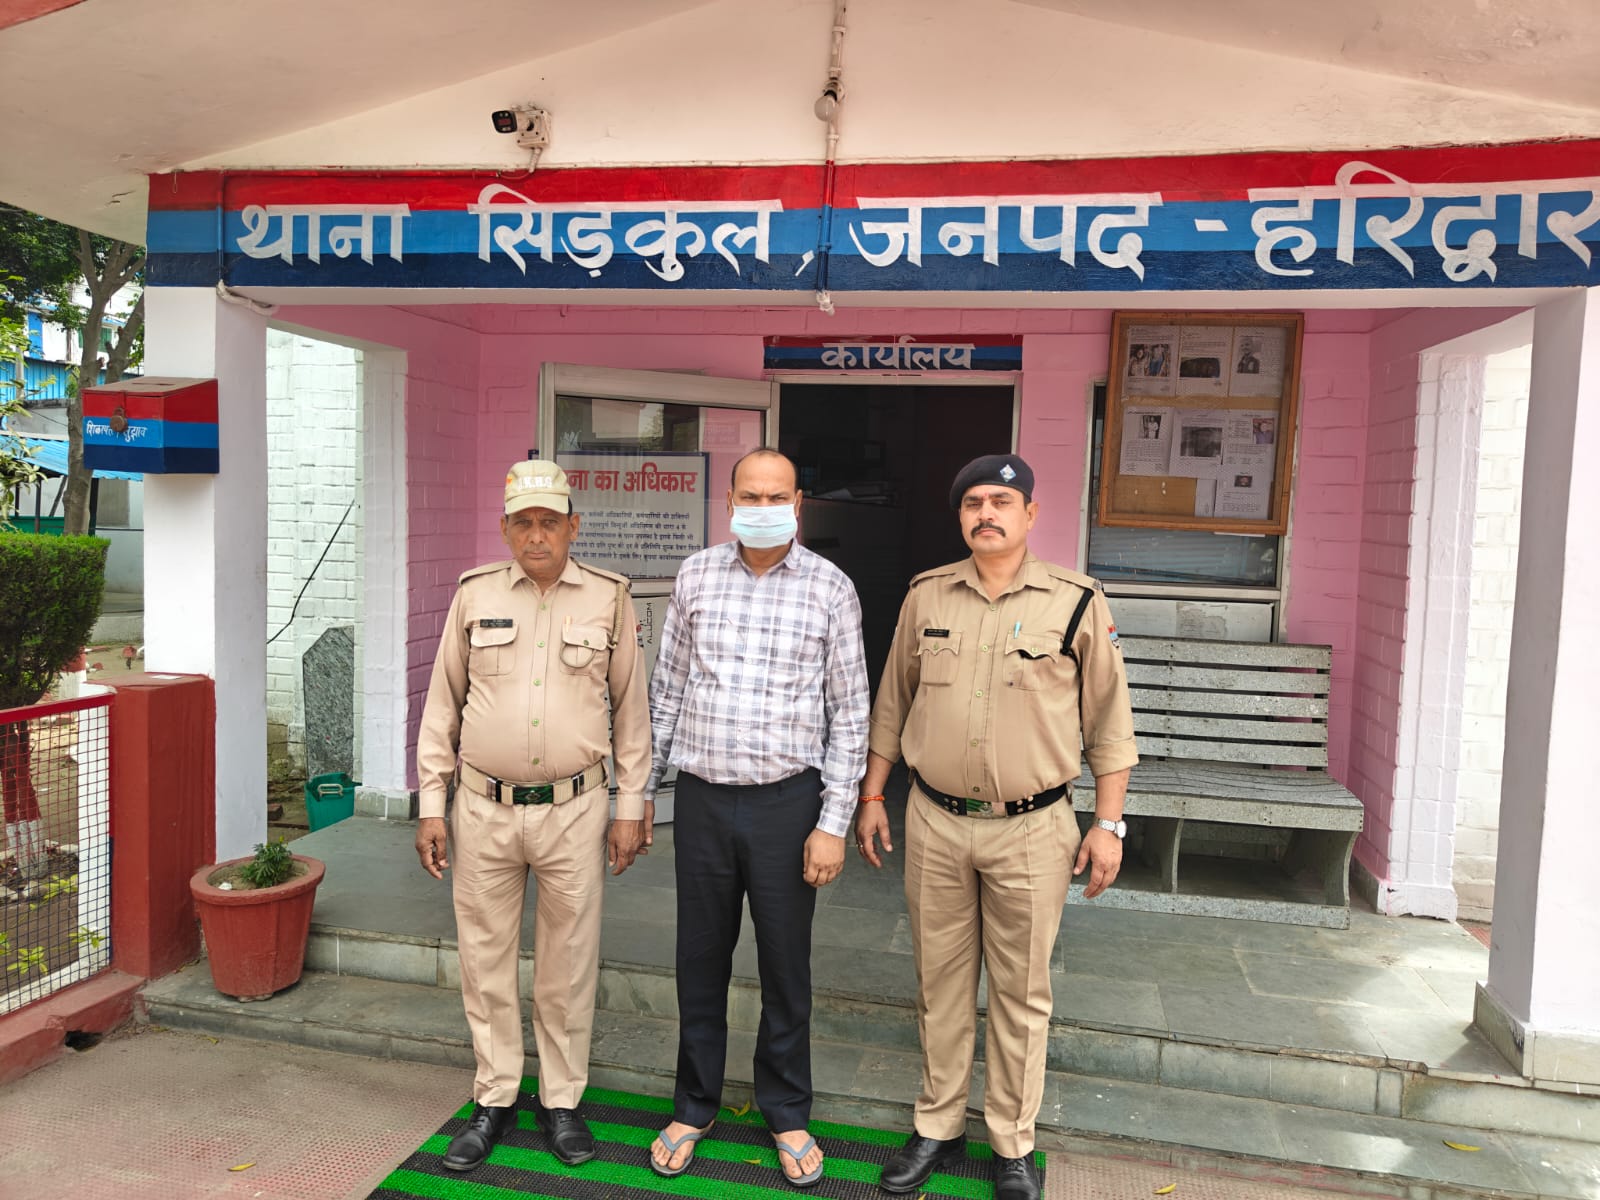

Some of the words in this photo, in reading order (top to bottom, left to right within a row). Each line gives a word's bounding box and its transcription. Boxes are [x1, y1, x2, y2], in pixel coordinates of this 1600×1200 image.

[235, 203, 411, 266] थाना
[848, 191, 1163, 283] जनपद
[1246, 160, 1600, 284] हरिद्वार
[820, 334, 976, 370] कार्यालय
[594, 470, 620, 492] का
[623, 462, 698, 493] अधिकार
